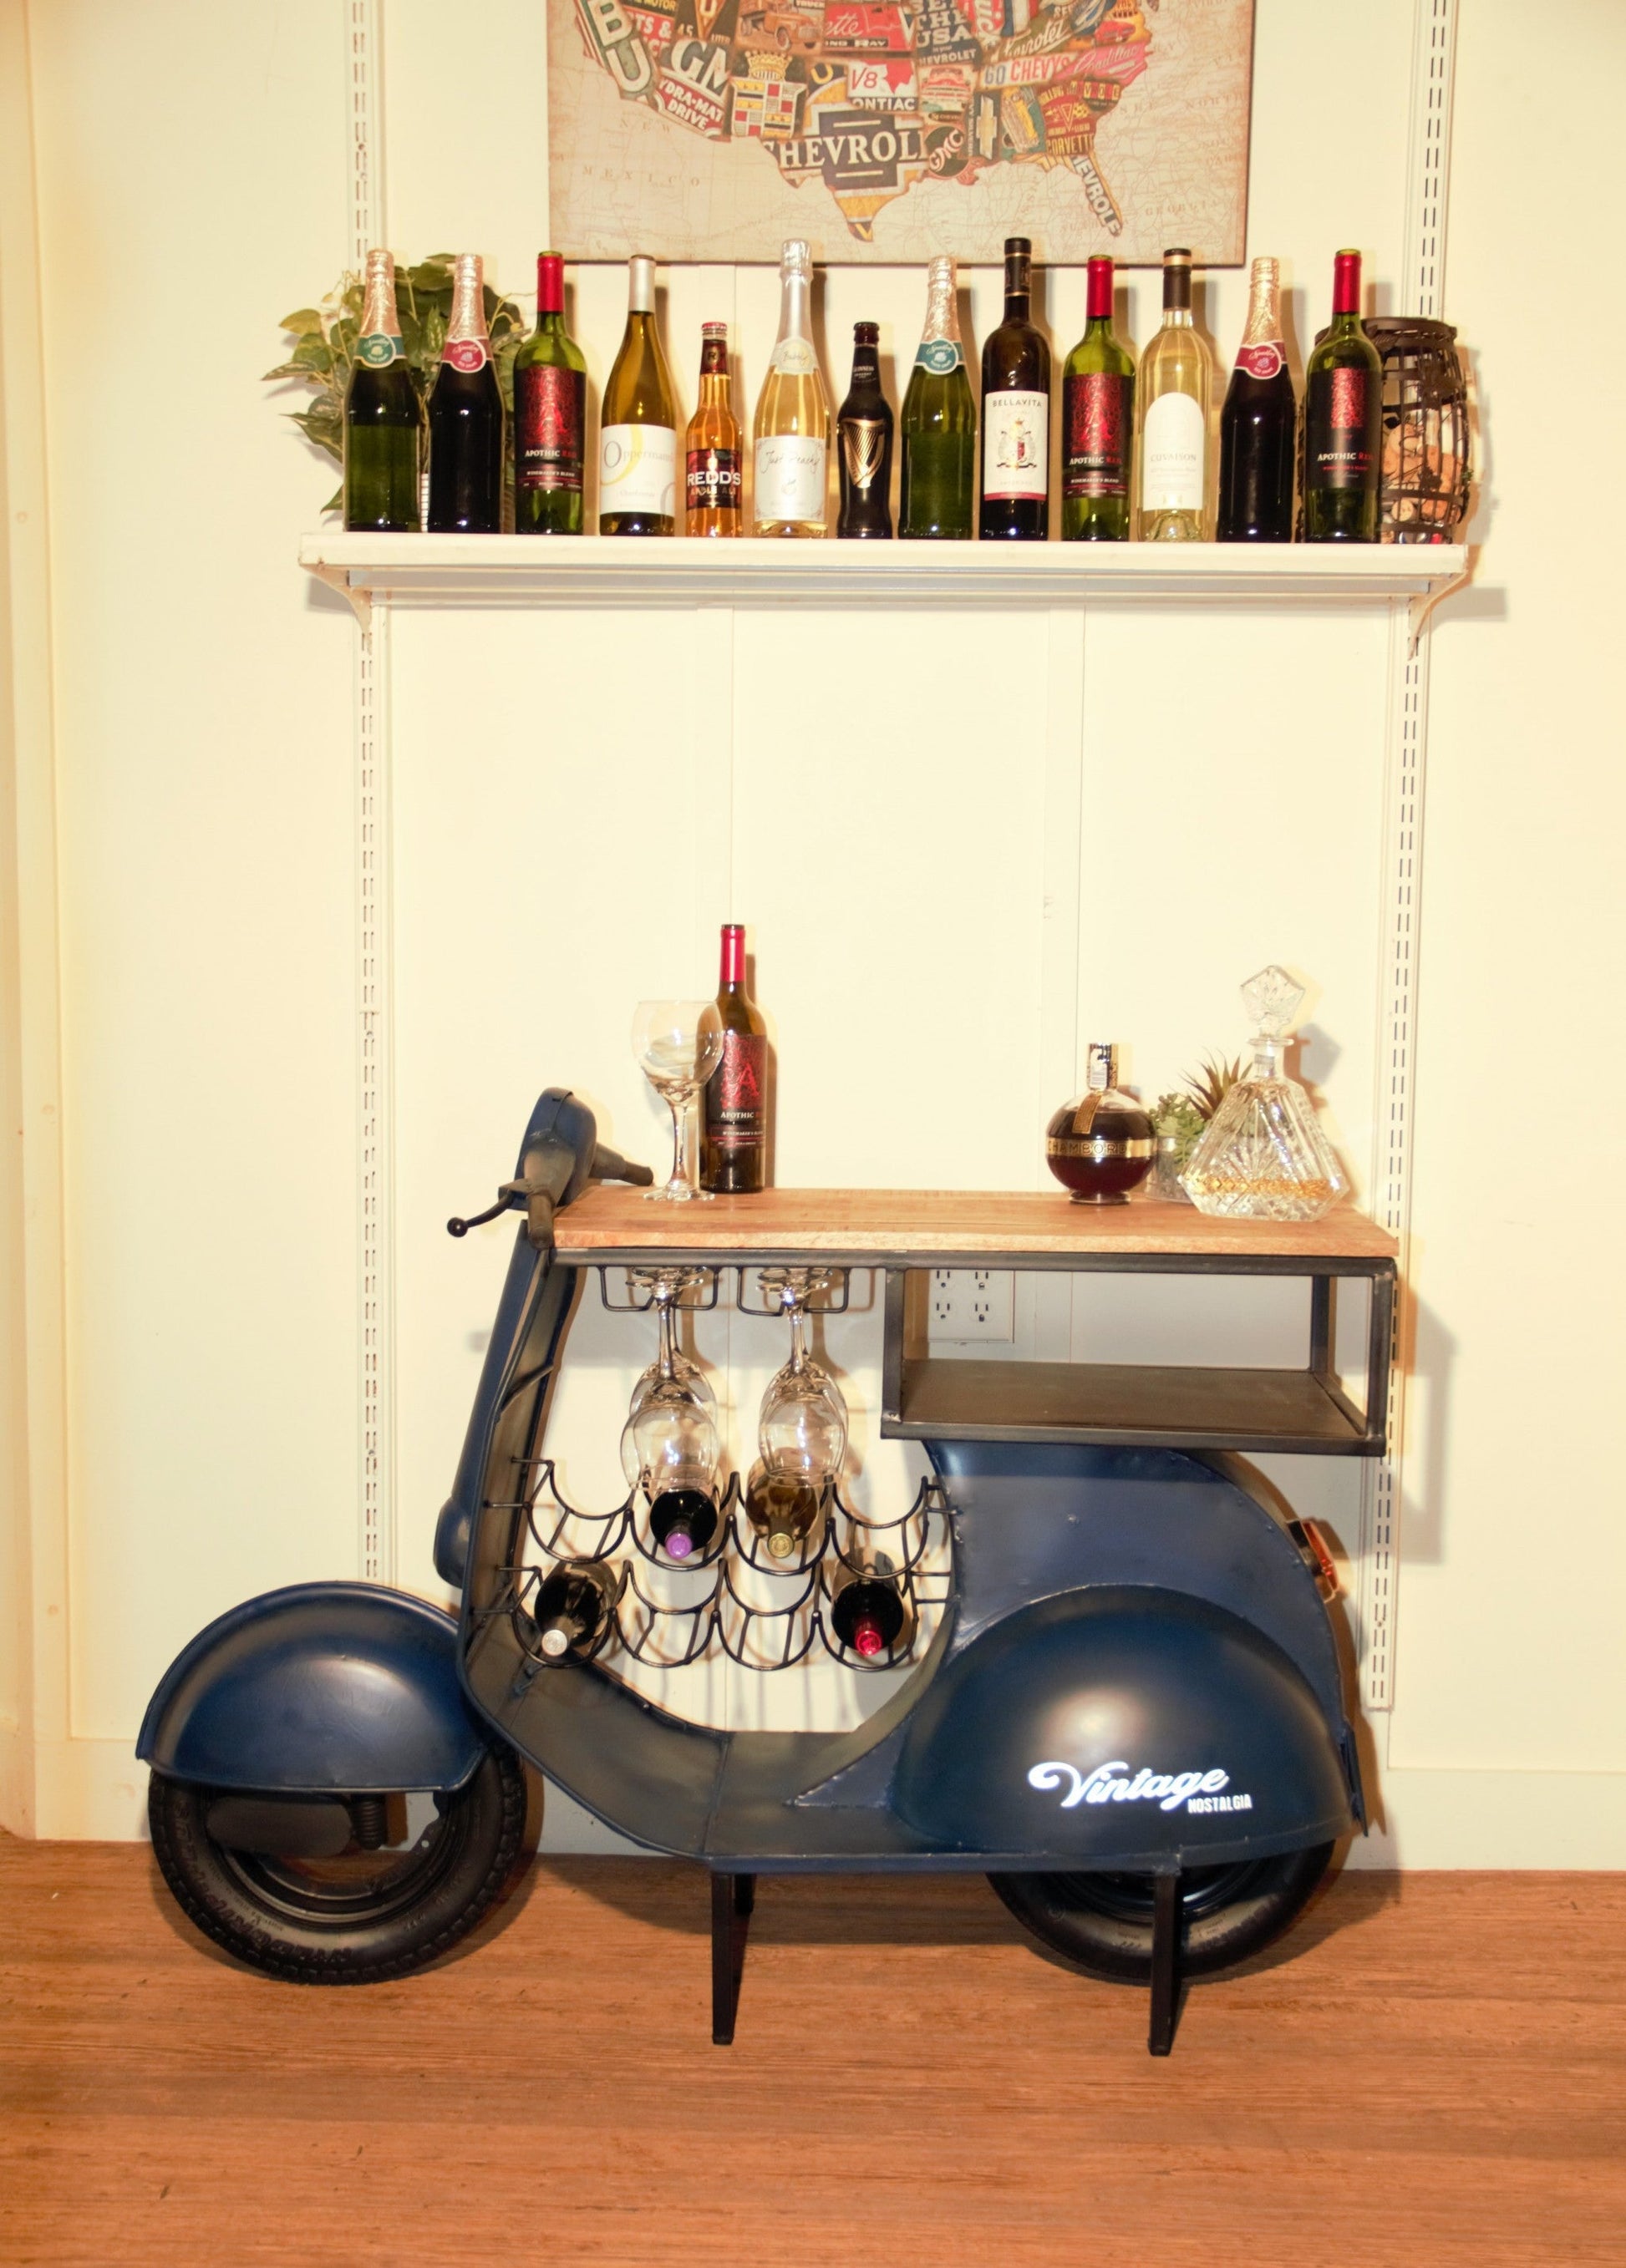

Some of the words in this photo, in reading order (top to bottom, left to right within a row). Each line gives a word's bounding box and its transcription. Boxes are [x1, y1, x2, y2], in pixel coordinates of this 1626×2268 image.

[852, 67, 878, 91] V8
[852, 99, 916, 110] ONTIAC
[668, 99, 709, 129] DRIVE
[929, 129, 963, 172] GMC
[992, 399, 1042, 408] BELLAVITA
[525, 449, 561, 458] APOTHIC
[1317, 452, 1356, 461] APOTHIC
[1070, 456, 1104, 465] APOTHIC
[688, 471, 741, 486] REDD'S
[1049, 1142, 1125, 1154] CHAMBORD
[1028, 1761, 1230, 1811] Vintage
[1187, 1794, 1253, 1814] NOSTALGIA
